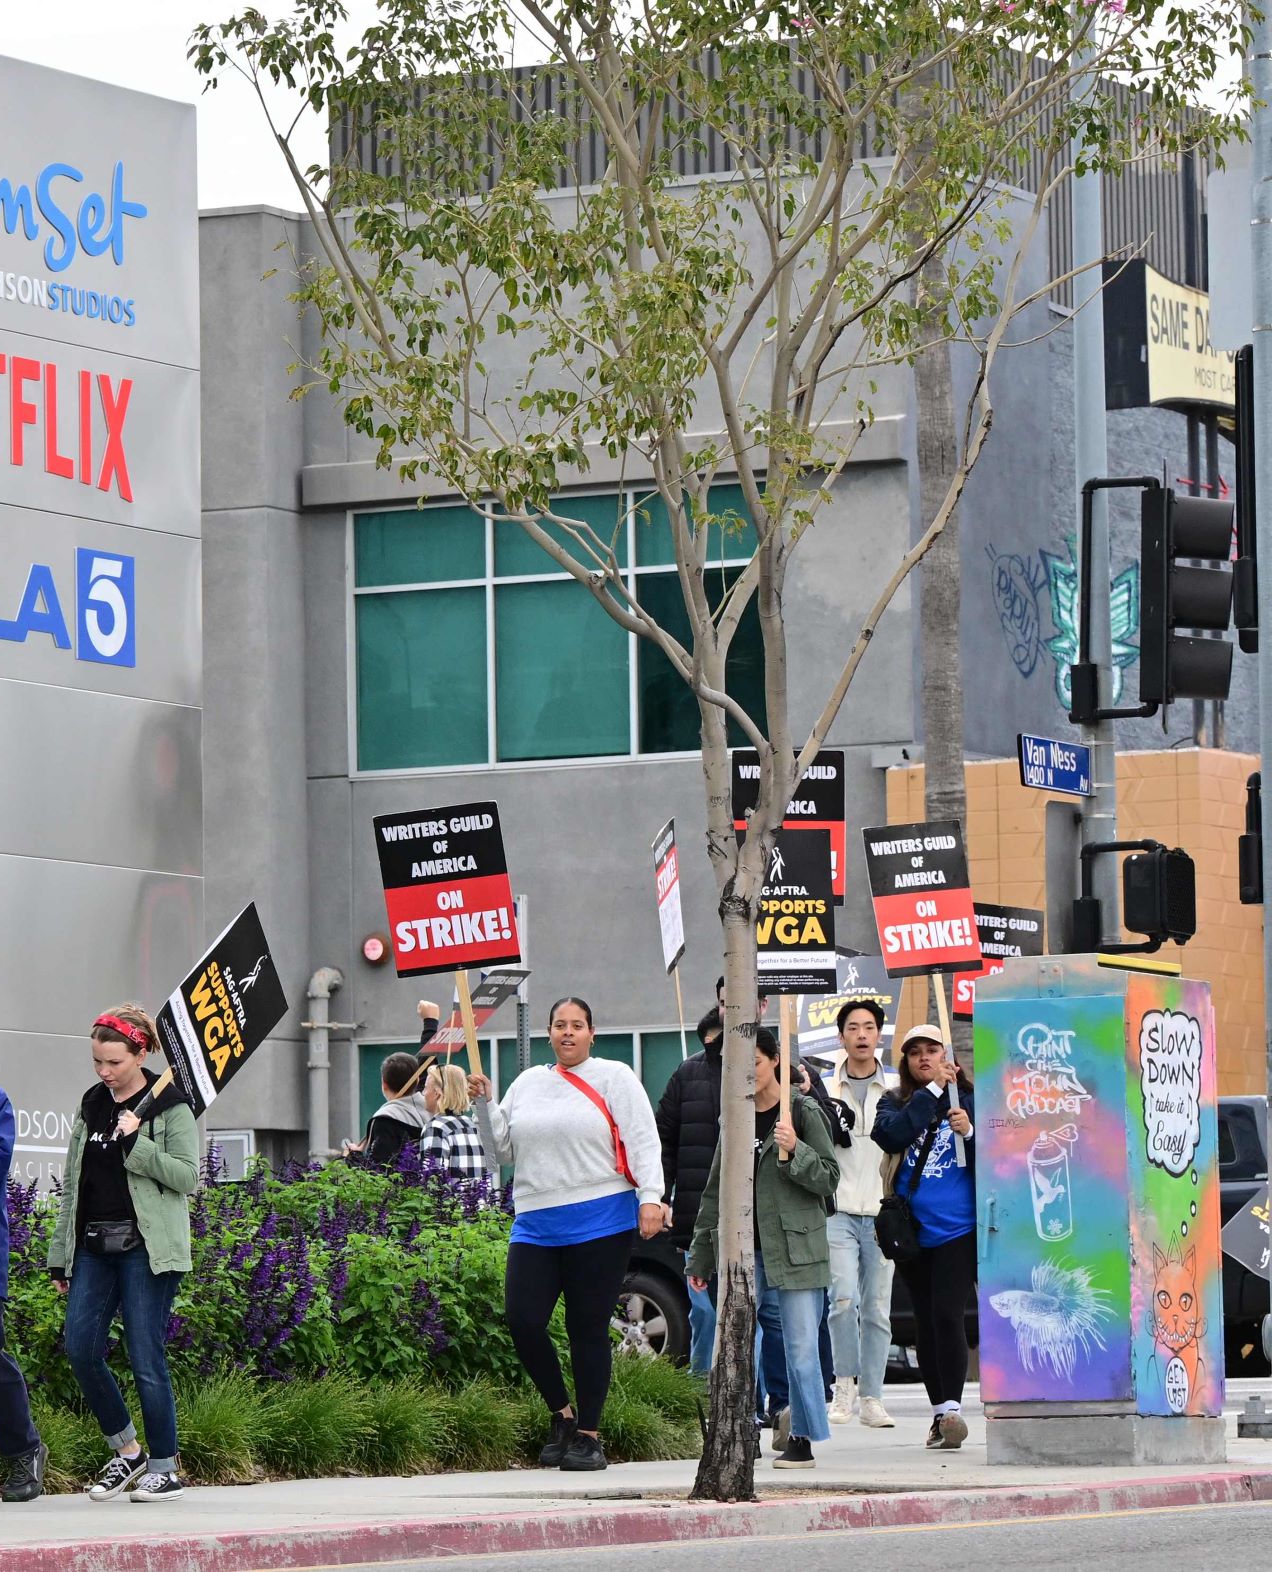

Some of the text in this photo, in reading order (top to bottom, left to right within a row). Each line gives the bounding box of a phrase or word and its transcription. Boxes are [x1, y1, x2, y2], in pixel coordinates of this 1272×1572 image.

[1150, 293, 1218, 358] SAME DA
[1194, 366, 1217, 389] MOST
[84, 557, 128, 659] 5
[1026, 738, 1077, 772] Van Ness
[1027, 765, 1054, 785] 1400 N
[786, 800, 817, 814] RICA
[382, 814, 493, 843] WRITERS GUILD
[432, 840, 448, 854] OF
[870, 835, 956, 856] WRITERS GUILD
[411, 855, 477, 879] AMERICA
[911, 856, 924, 868] OF
[895, 870, 946, 888] AMERICA
[437, 889, 464, 911] ON
[916, 900, 937, 917] ON
[395, 907, 512, 953] STRIKE!
[884, 917, 973, 953] STRIKE!
[974, 915, 1039, 932] RITERS GUILD
[994, 931, 1006, 941] OF
[207, 961, 245, 1059] SUPPORTS
[190, 971, 232, 1081] WGA
[1013, 1067, 1087, 1095] TOWN
[1147, 1058, 1195, 1088] DOWN
[1007, 1090, 1092, 1119] PODCAST
[1155, 1093, 1185, 1114] take it
[1153, 1120, 1187, 1165] Easy
[1168, 1364, 1185, 1384] GET
